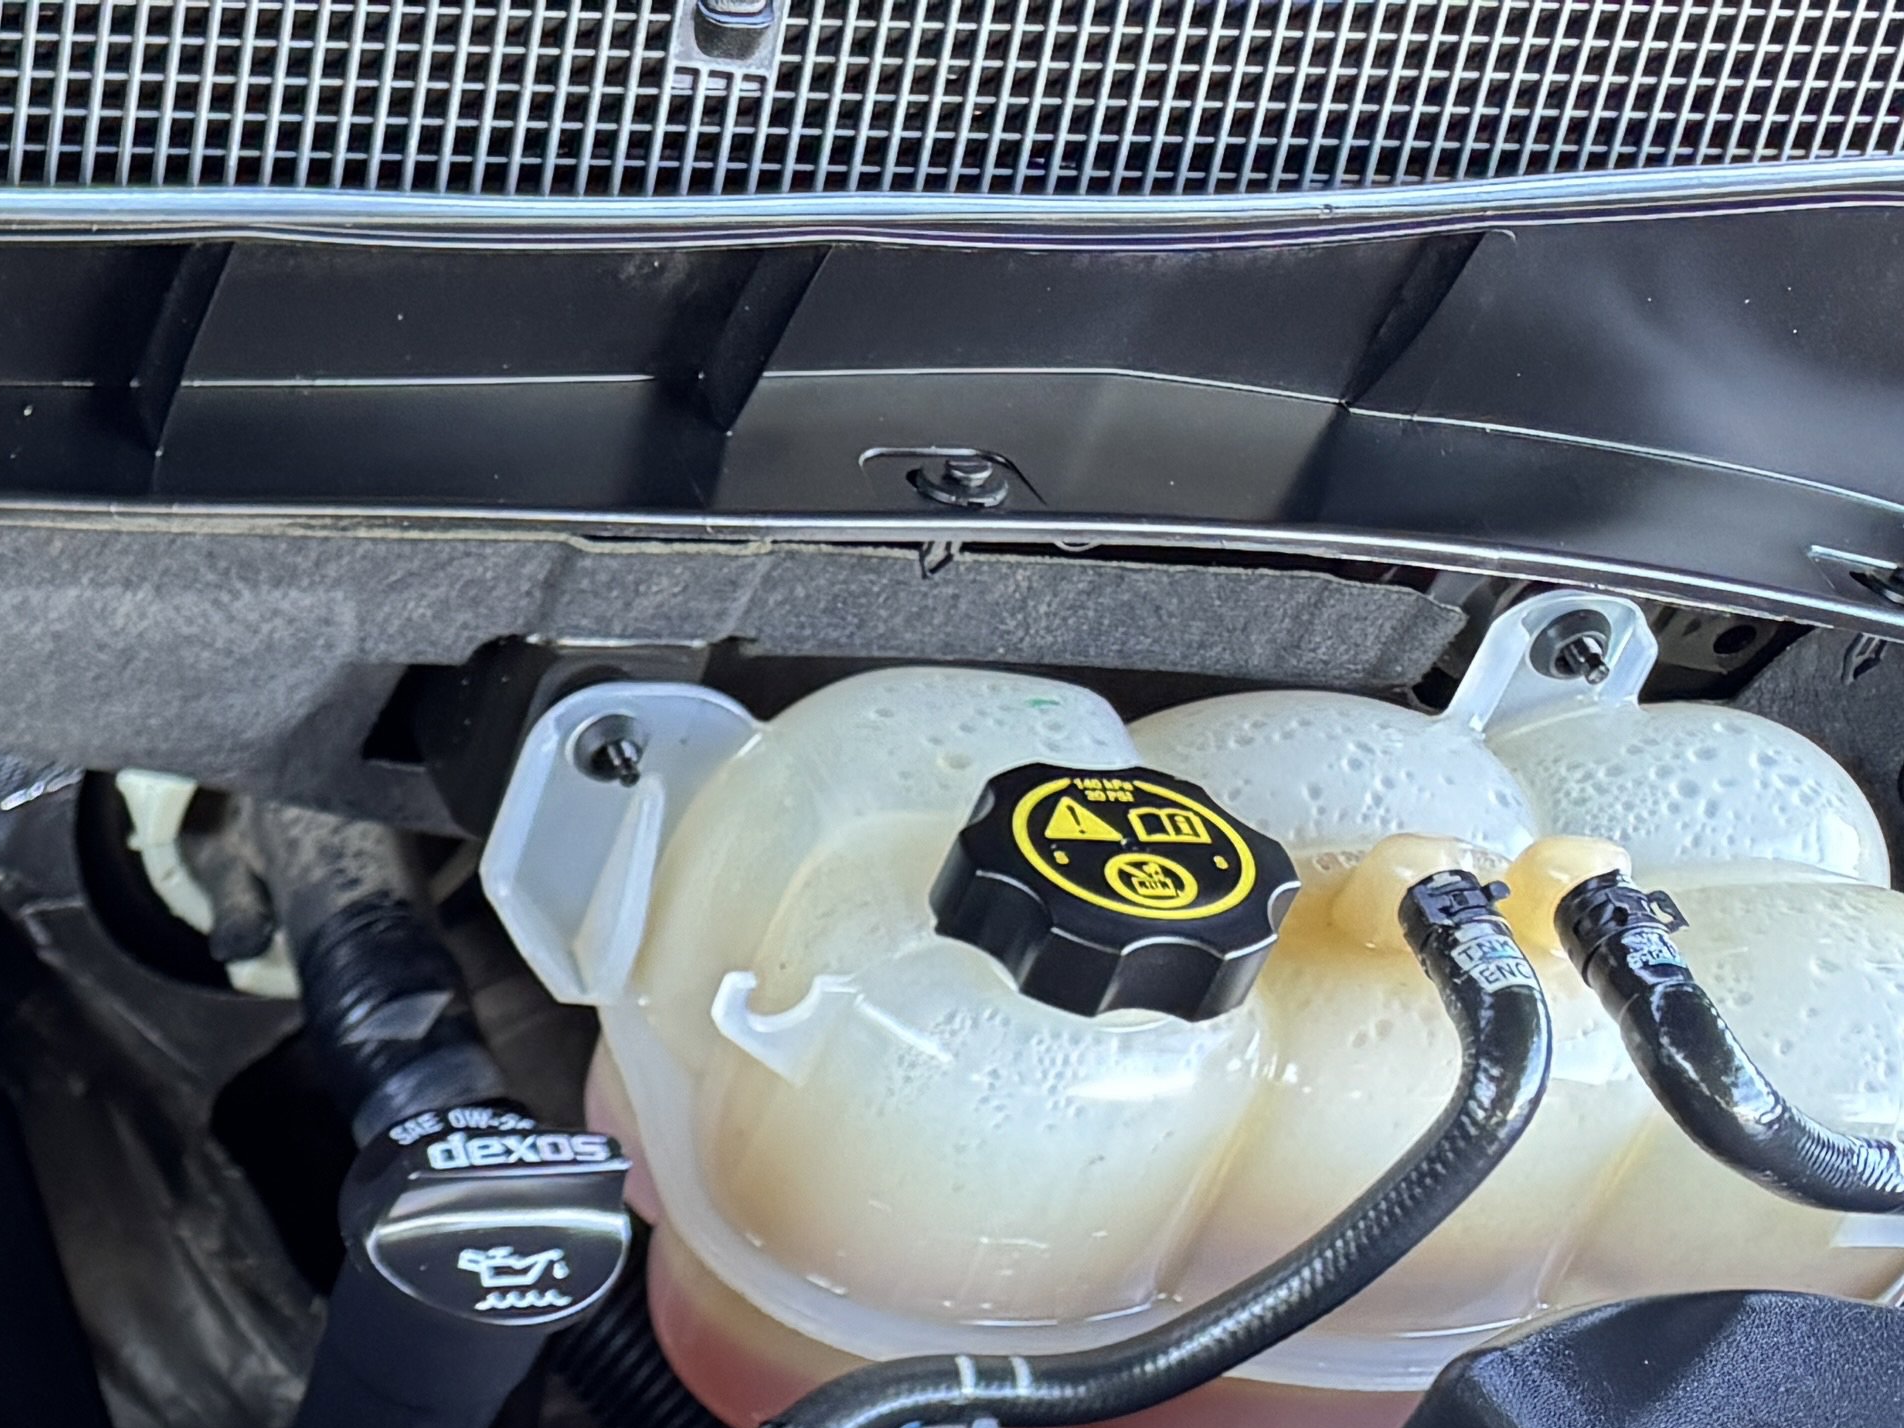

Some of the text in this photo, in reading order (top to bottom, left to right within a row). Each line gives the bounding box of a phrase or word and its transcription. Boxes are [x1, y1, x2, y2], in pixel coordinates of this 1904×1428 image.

[1073, 777, 1102, 790] 140
[1107, 791, 1136, 803] PSI
[389, 1111, 443, 1145] SAE
[427, 1131, 611, 1169] dexos
